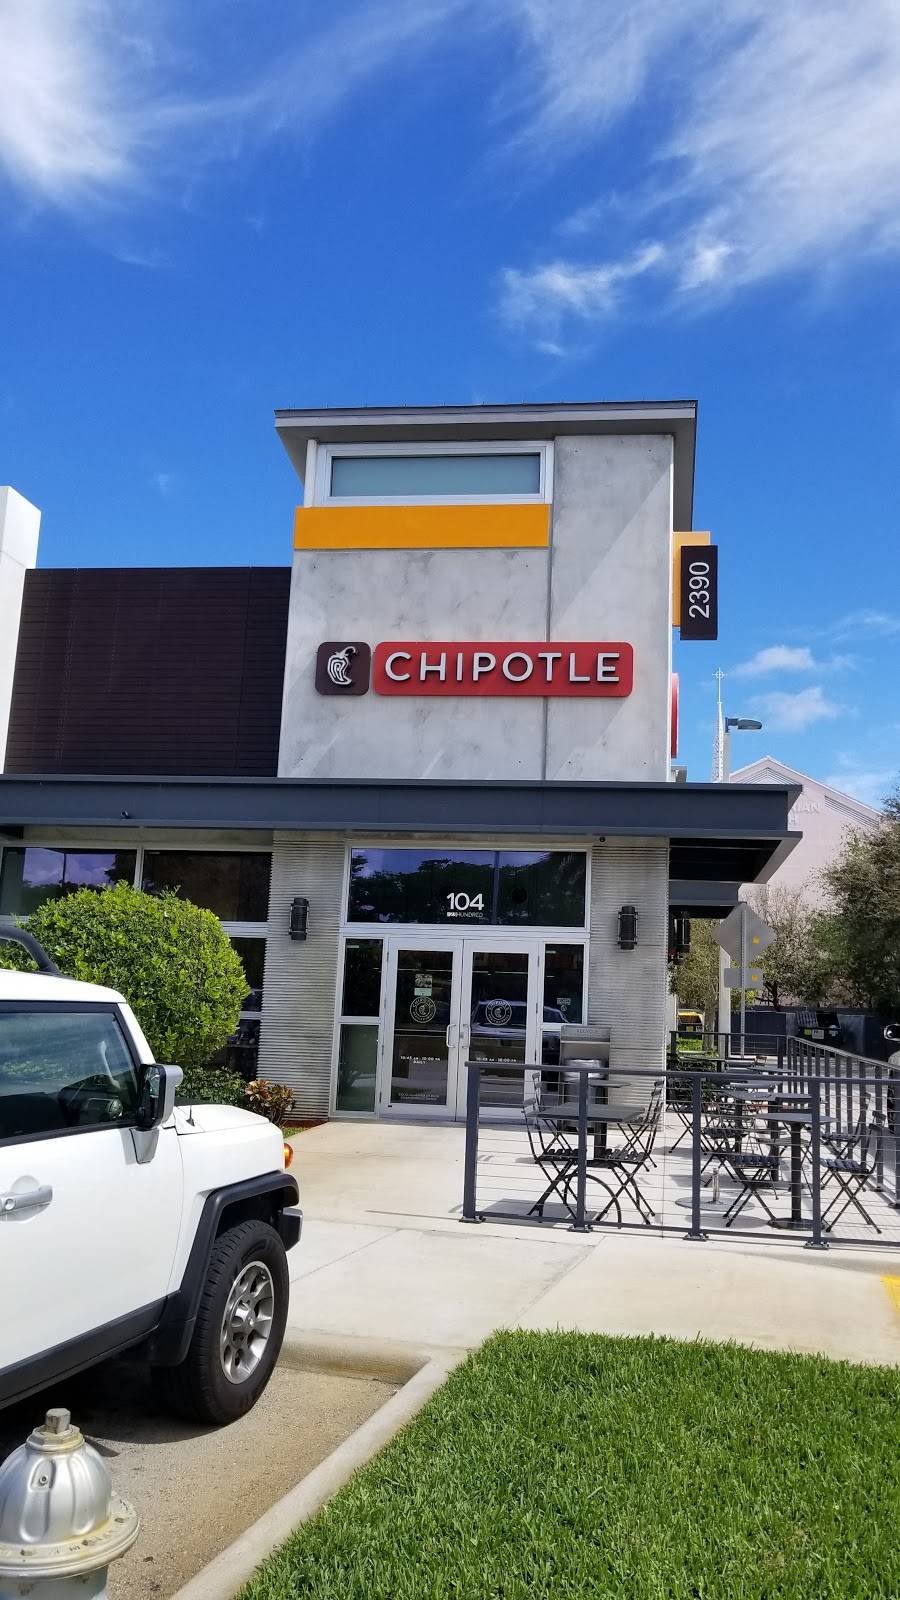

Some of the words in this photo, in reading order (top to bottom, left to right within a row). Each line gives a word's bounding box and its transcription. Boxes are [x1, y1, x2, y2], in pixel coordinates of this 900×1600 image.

[688, 562, 710, 618] 2390
[385, 651, 621, 682] CHIPOTLE
[446, 892, 485, 911] 104
